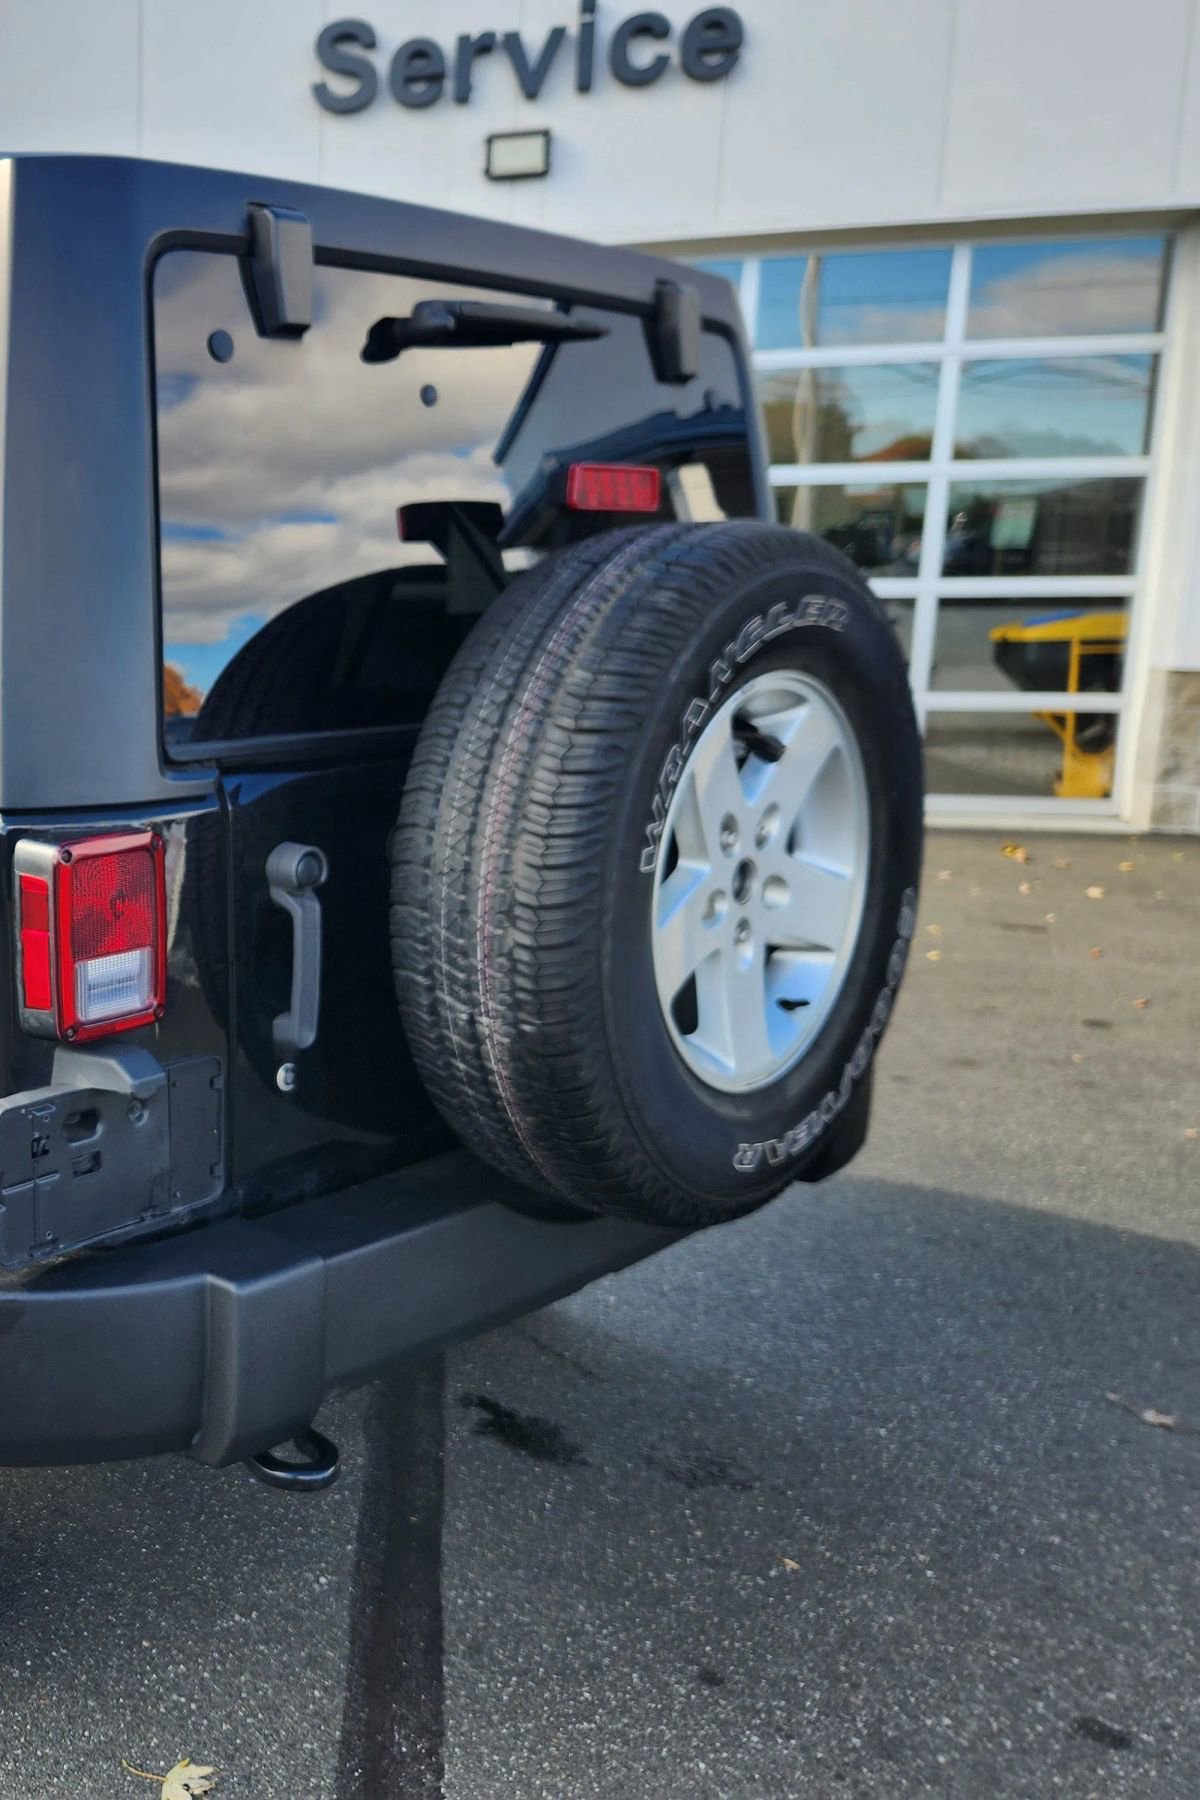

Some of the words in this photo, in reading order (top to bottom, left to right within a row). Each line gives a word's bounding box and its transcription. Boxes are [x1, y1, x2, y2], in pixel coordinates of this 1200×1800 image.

[312, 0, 745, 115] Service
[640, 594, 849, 873] WRANGLER
[732, 886, 915, 1172] GOODYEAR
